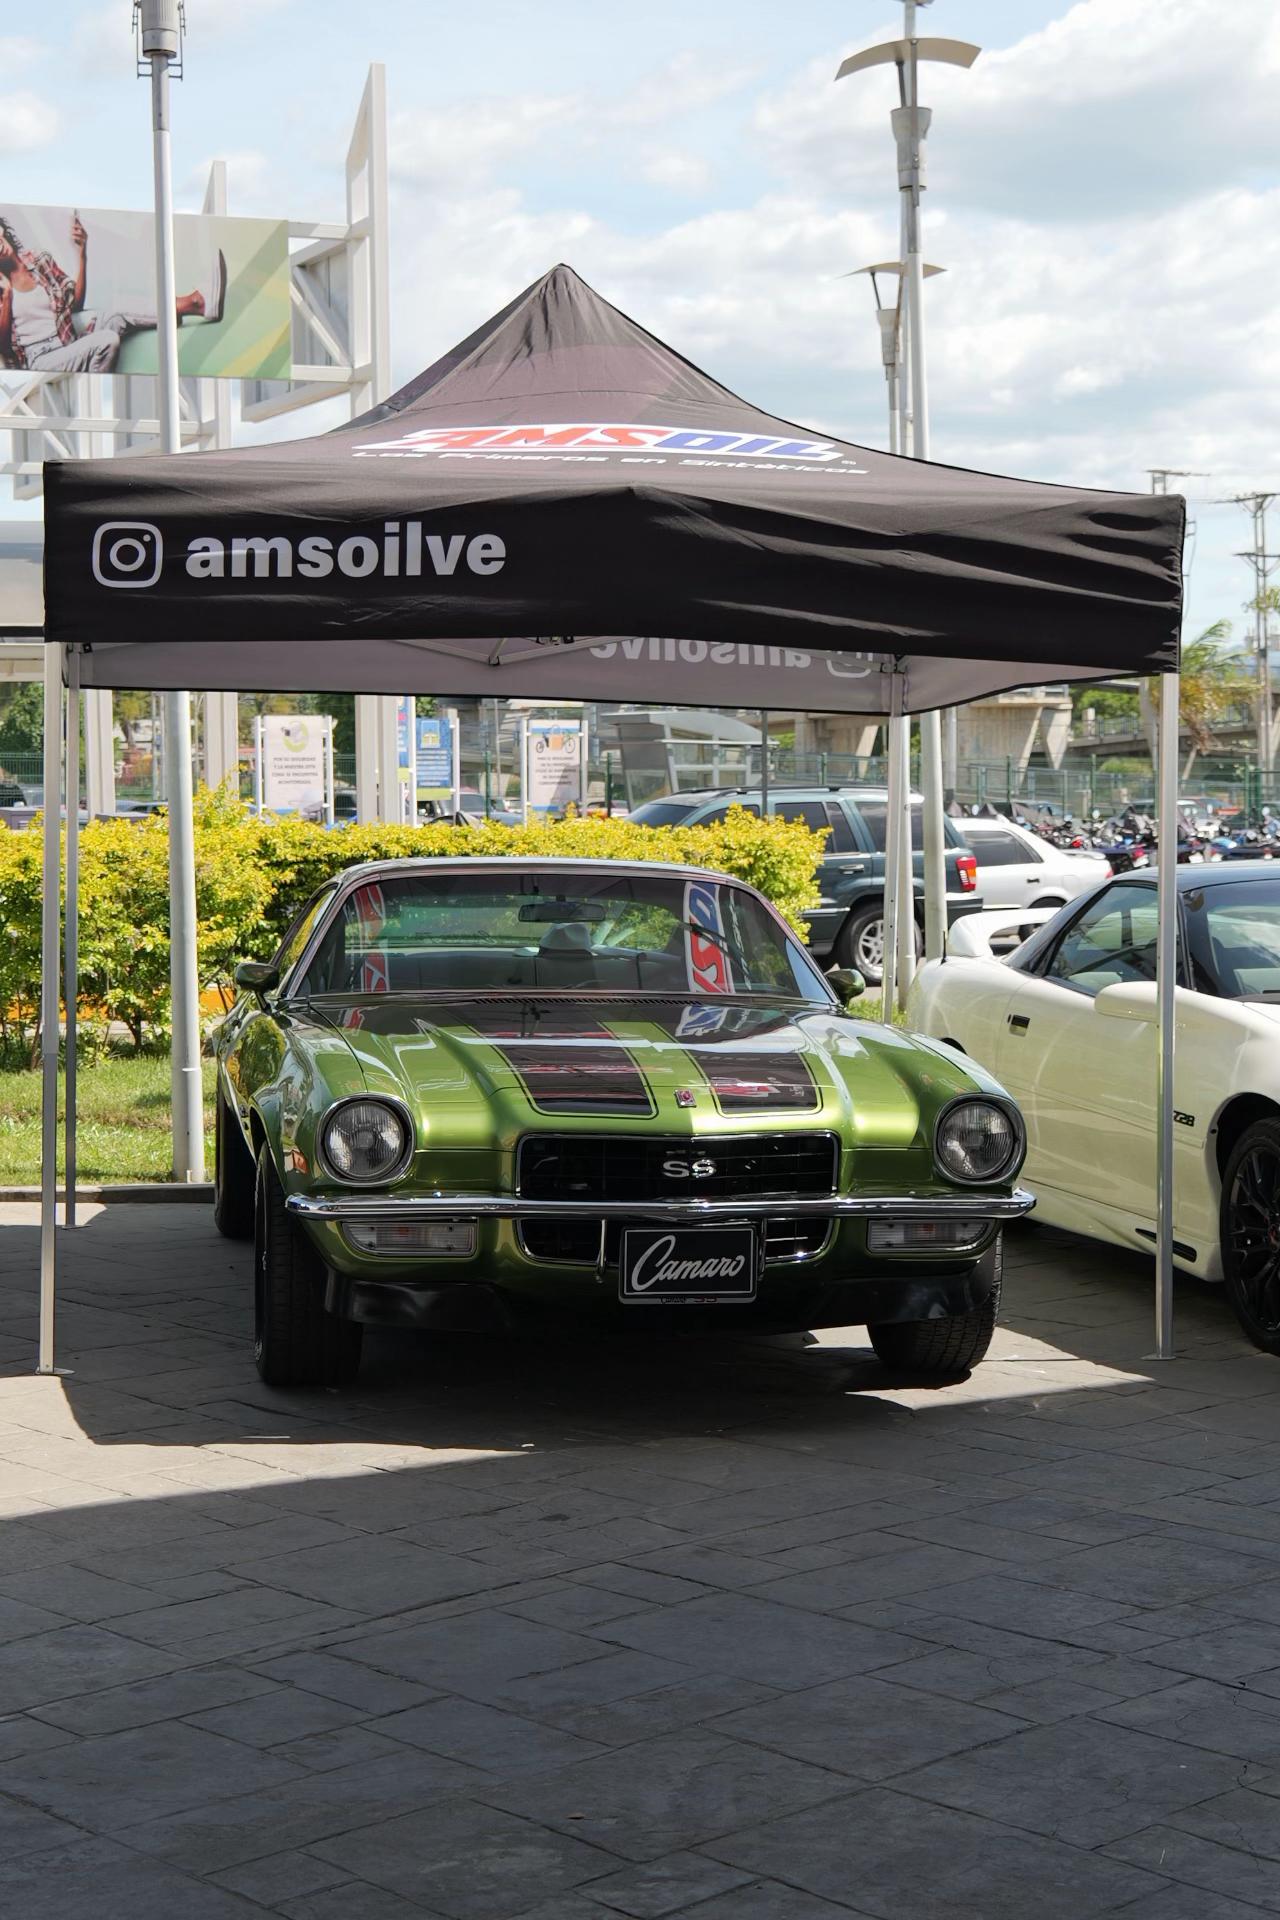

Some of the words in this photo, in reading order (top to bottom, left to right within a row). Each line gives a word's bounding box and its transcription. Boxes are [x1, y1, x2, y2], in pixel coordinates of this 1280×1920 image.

[354, 424, 843, 461] AMSOIL
[438, 452, 609, 462] Primeros
[185, 521, 507, 578] amsoilve
[1173, 1110, 1195, 1127] Z28
[663, 1160, 715, 1178] SS
[631, 1235, 746, 1292] Camaro
